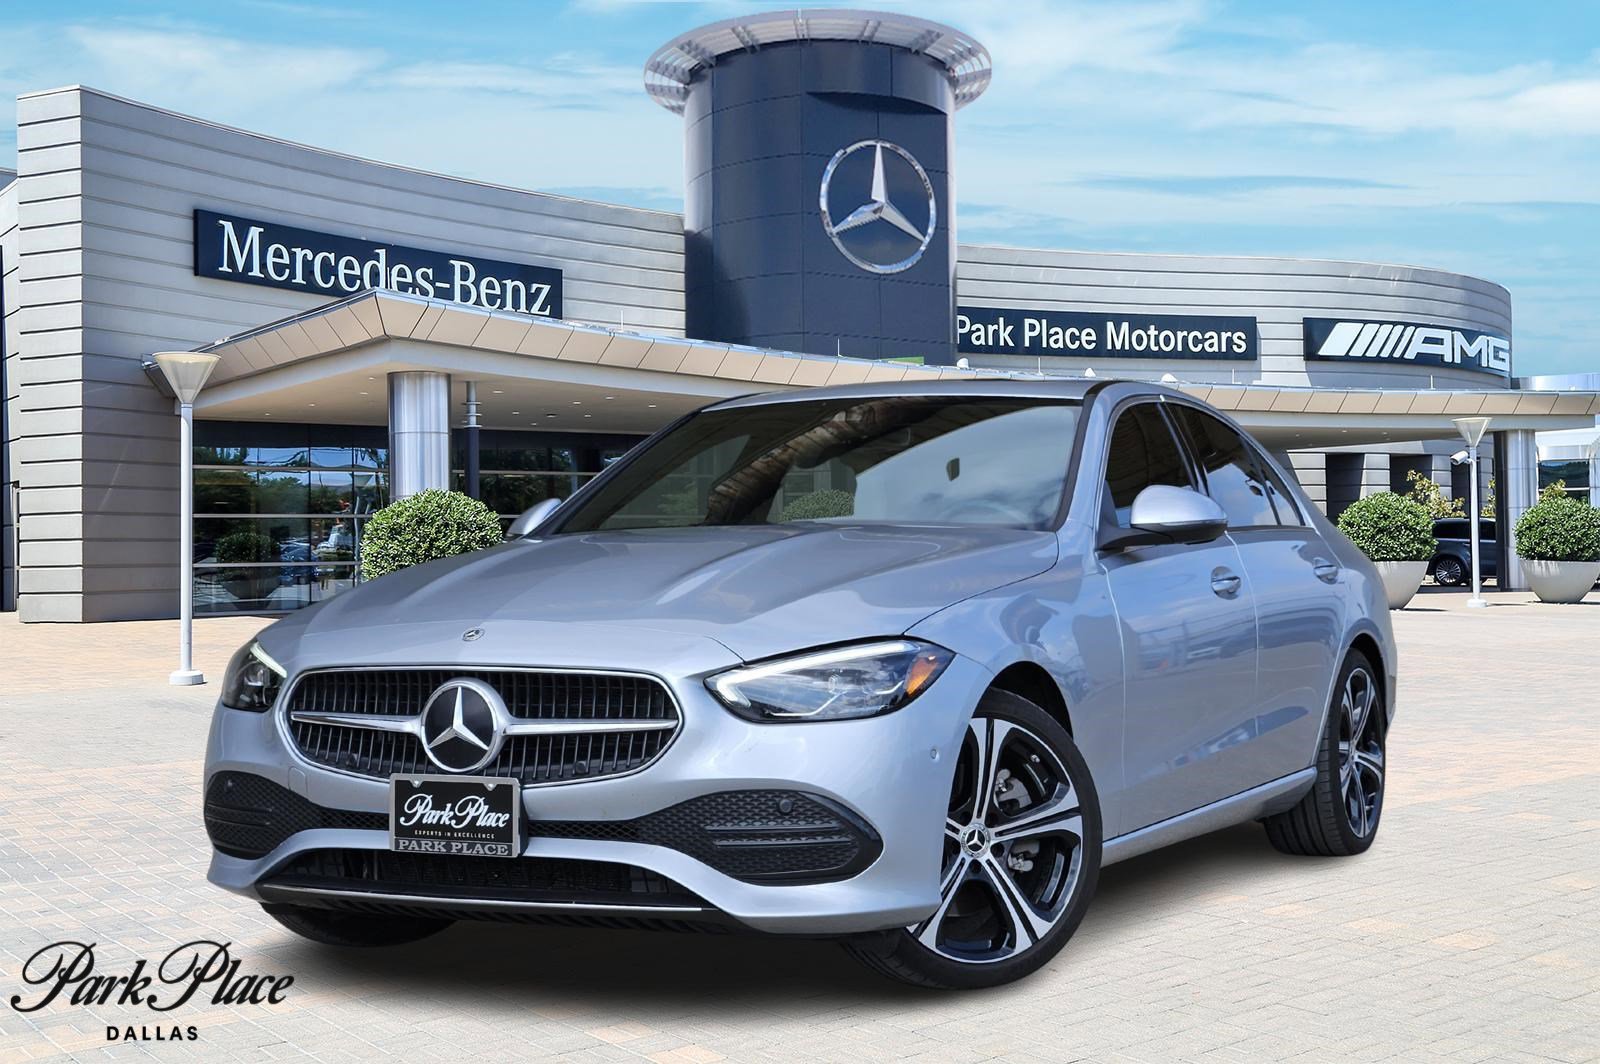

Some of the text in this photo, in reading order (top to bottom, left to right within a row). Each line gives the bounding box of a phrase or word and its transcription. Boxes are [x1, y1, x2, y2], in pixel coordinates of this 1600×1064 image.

[218, 220, 552, 316] Mercedes-Benz
[957, 315, 1248, 353] Park Place Motorcars
[400, 793, 510, 829] Park Place
[398, 839, 509, 856] PARK PLACE
[414, 829, 442, 837] EXPERTS
